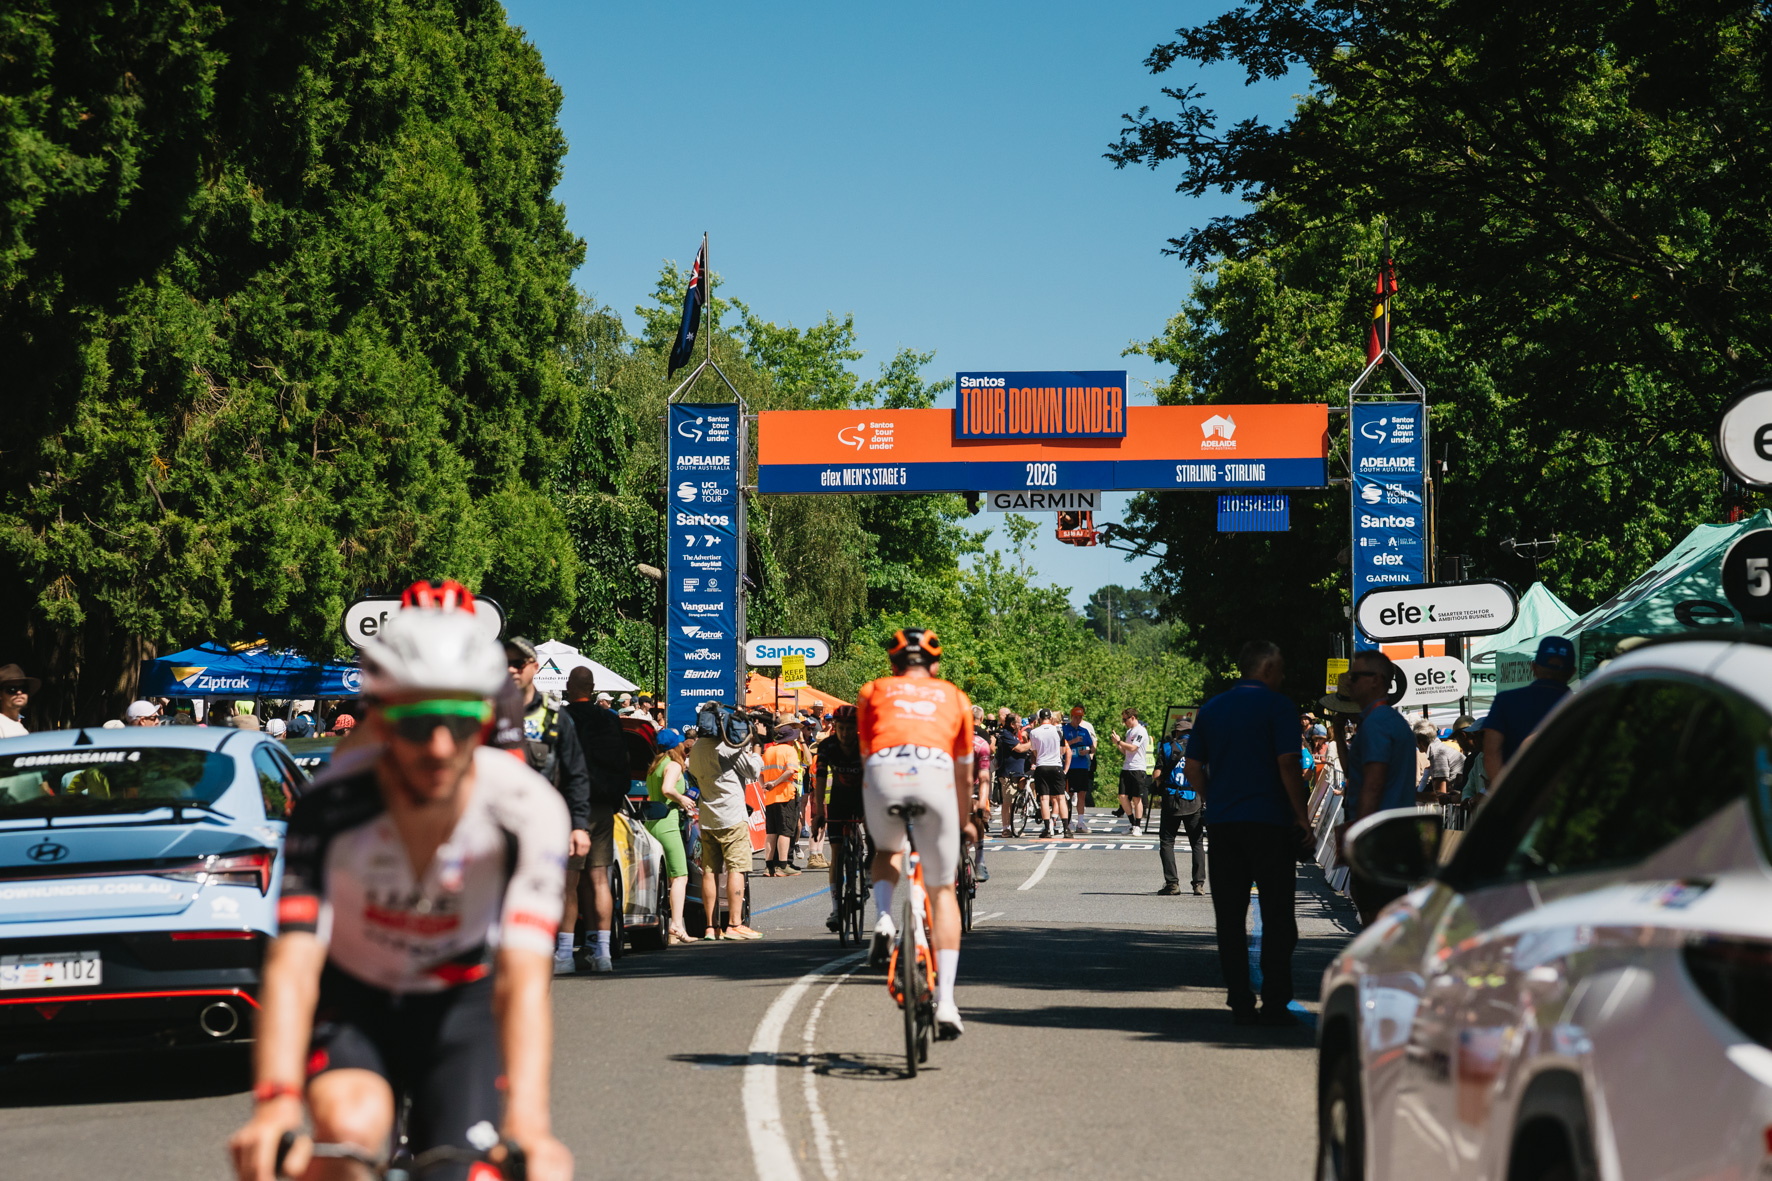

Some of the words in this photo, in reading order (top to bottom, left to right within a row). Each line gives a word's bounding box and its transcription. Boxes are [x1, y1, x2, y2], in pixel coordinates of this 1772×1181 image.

[961, 376, 1005, 387] Santos
[961, 388, 1006, 434] TOUR
[1009, 388, 1062, 434] DOWN
[1066, 387, 1123, 433] UNDER
[676, 456, 731, 466] ADELAIDE
[1360, 457, 1415, 467] ADELAIDE
[821, 469, 841, 486] efex
[843, 468, 871, 486] MEN'S
[872, 468, 899, 485] STAGE
[900, 467, 907, 485] 5
[1026, 463, 1057, 486] 2026
[1176, 464, 1216, 482] STIRLING
[1225, 464, 1265, 481] STIRLING
[994, 493, 1094, 509] GARMIN
[676, 513, 730, 526] Santos
[1361, 515, 1415, 528] Santos
[1373, 553, 1403, 565] efex
[1366, 574, 1409, 583] GARMIN
[681, 602, 724, 613] Vanguard
[1380, 602, 1437, 626] efex
[696, 631, 723, 640] Ziptrak
[684, 652, 721, 660] WHOOSH
[756, 644, 816, 658] Santos
[683, 669, 721, 679] Santini
[1414, 668, 1457, 686] efex
[198, 675, 249, 691] Ziptrak
[13, 752, 126, 768] COMMISSAIRE
[127, 752, 140, 762] 4
[0, 884, 171, 900] OWNUNDER.COM.AU
[63, 961, 95, 980] 102
